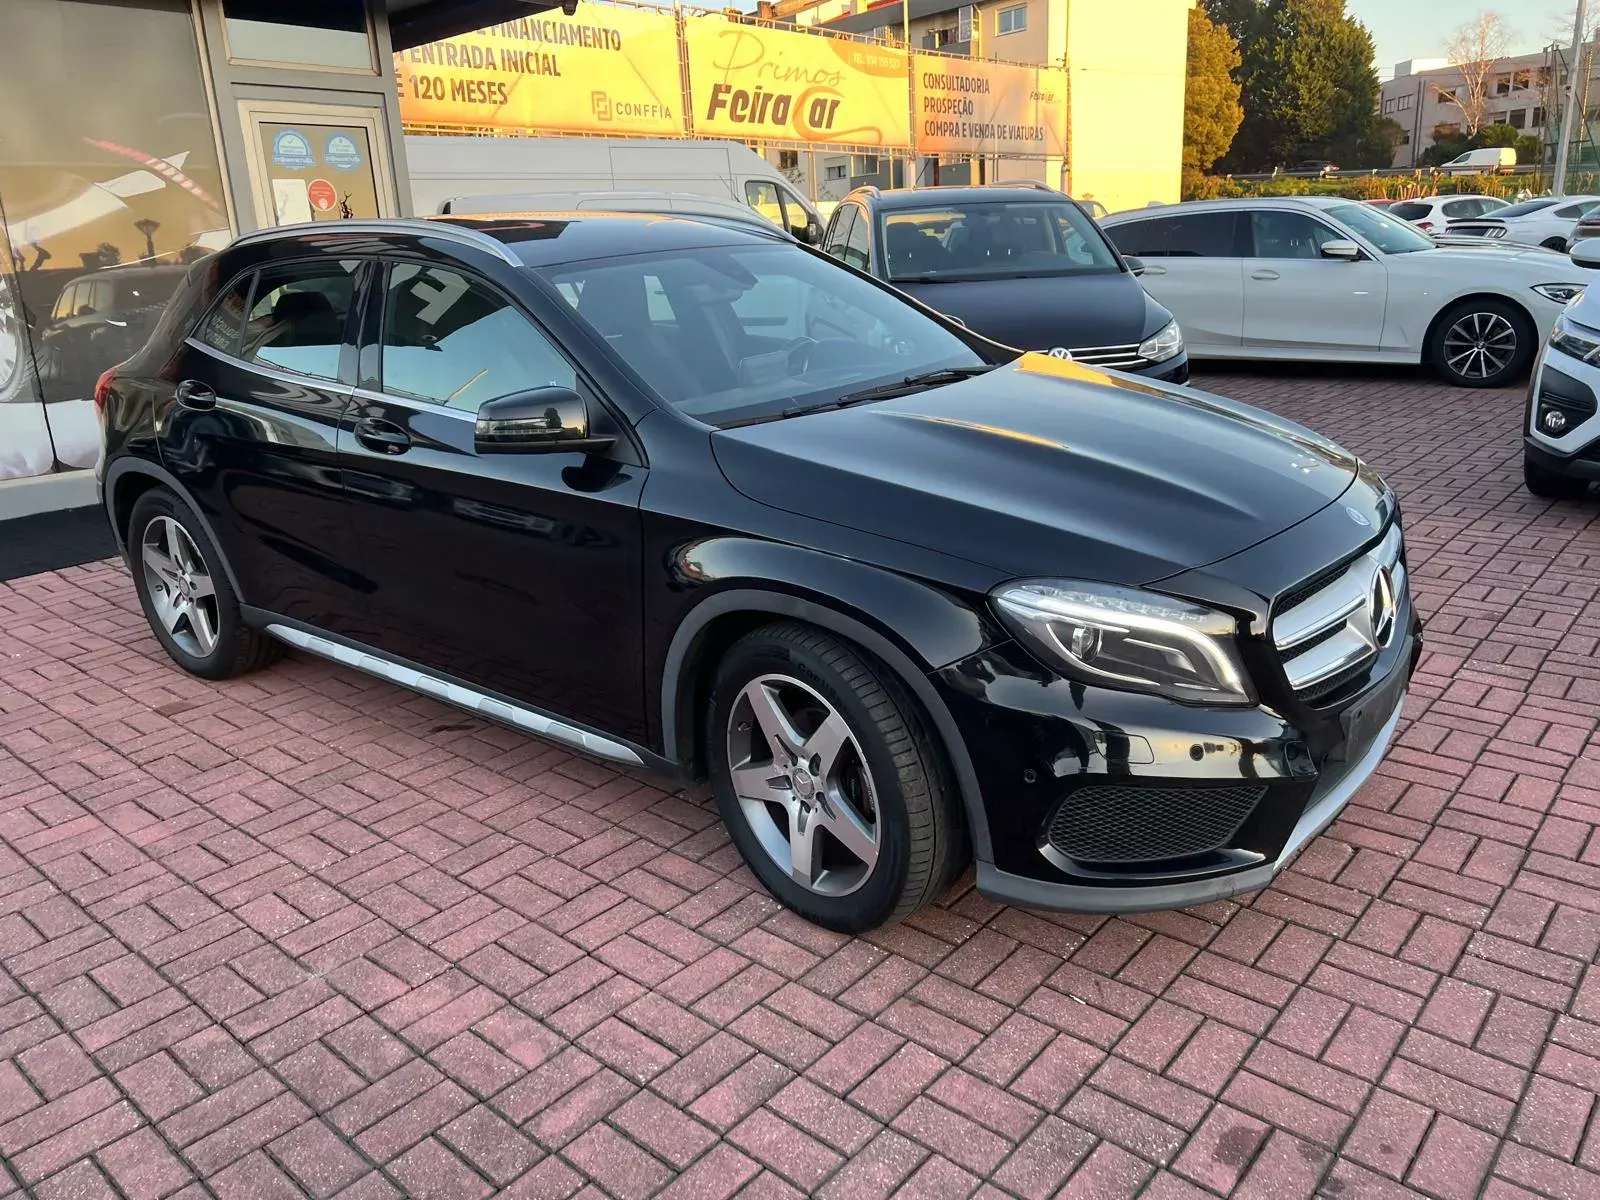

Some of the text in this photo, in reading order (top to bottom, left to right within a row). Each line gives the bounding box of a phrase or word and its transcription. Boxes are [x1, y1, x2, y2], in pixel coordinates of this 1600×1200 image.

[410, 41, 498, 71] ENTRADA
[500, 48, 562, 77] INICIAL
[712, 29, 847, 87] Primos
[408, 74, 446, 101] 120
[449, 77, 509, 106] MESES
[922, 72, 991, 94] CONSULTADORIA
[615, 102, 673, 120] CONFFIA
[923, 95, 974, 118] PROSPEÇÃO
[924, 120, 1044, 141] COMPRA E VENDA DE VIATURAS
